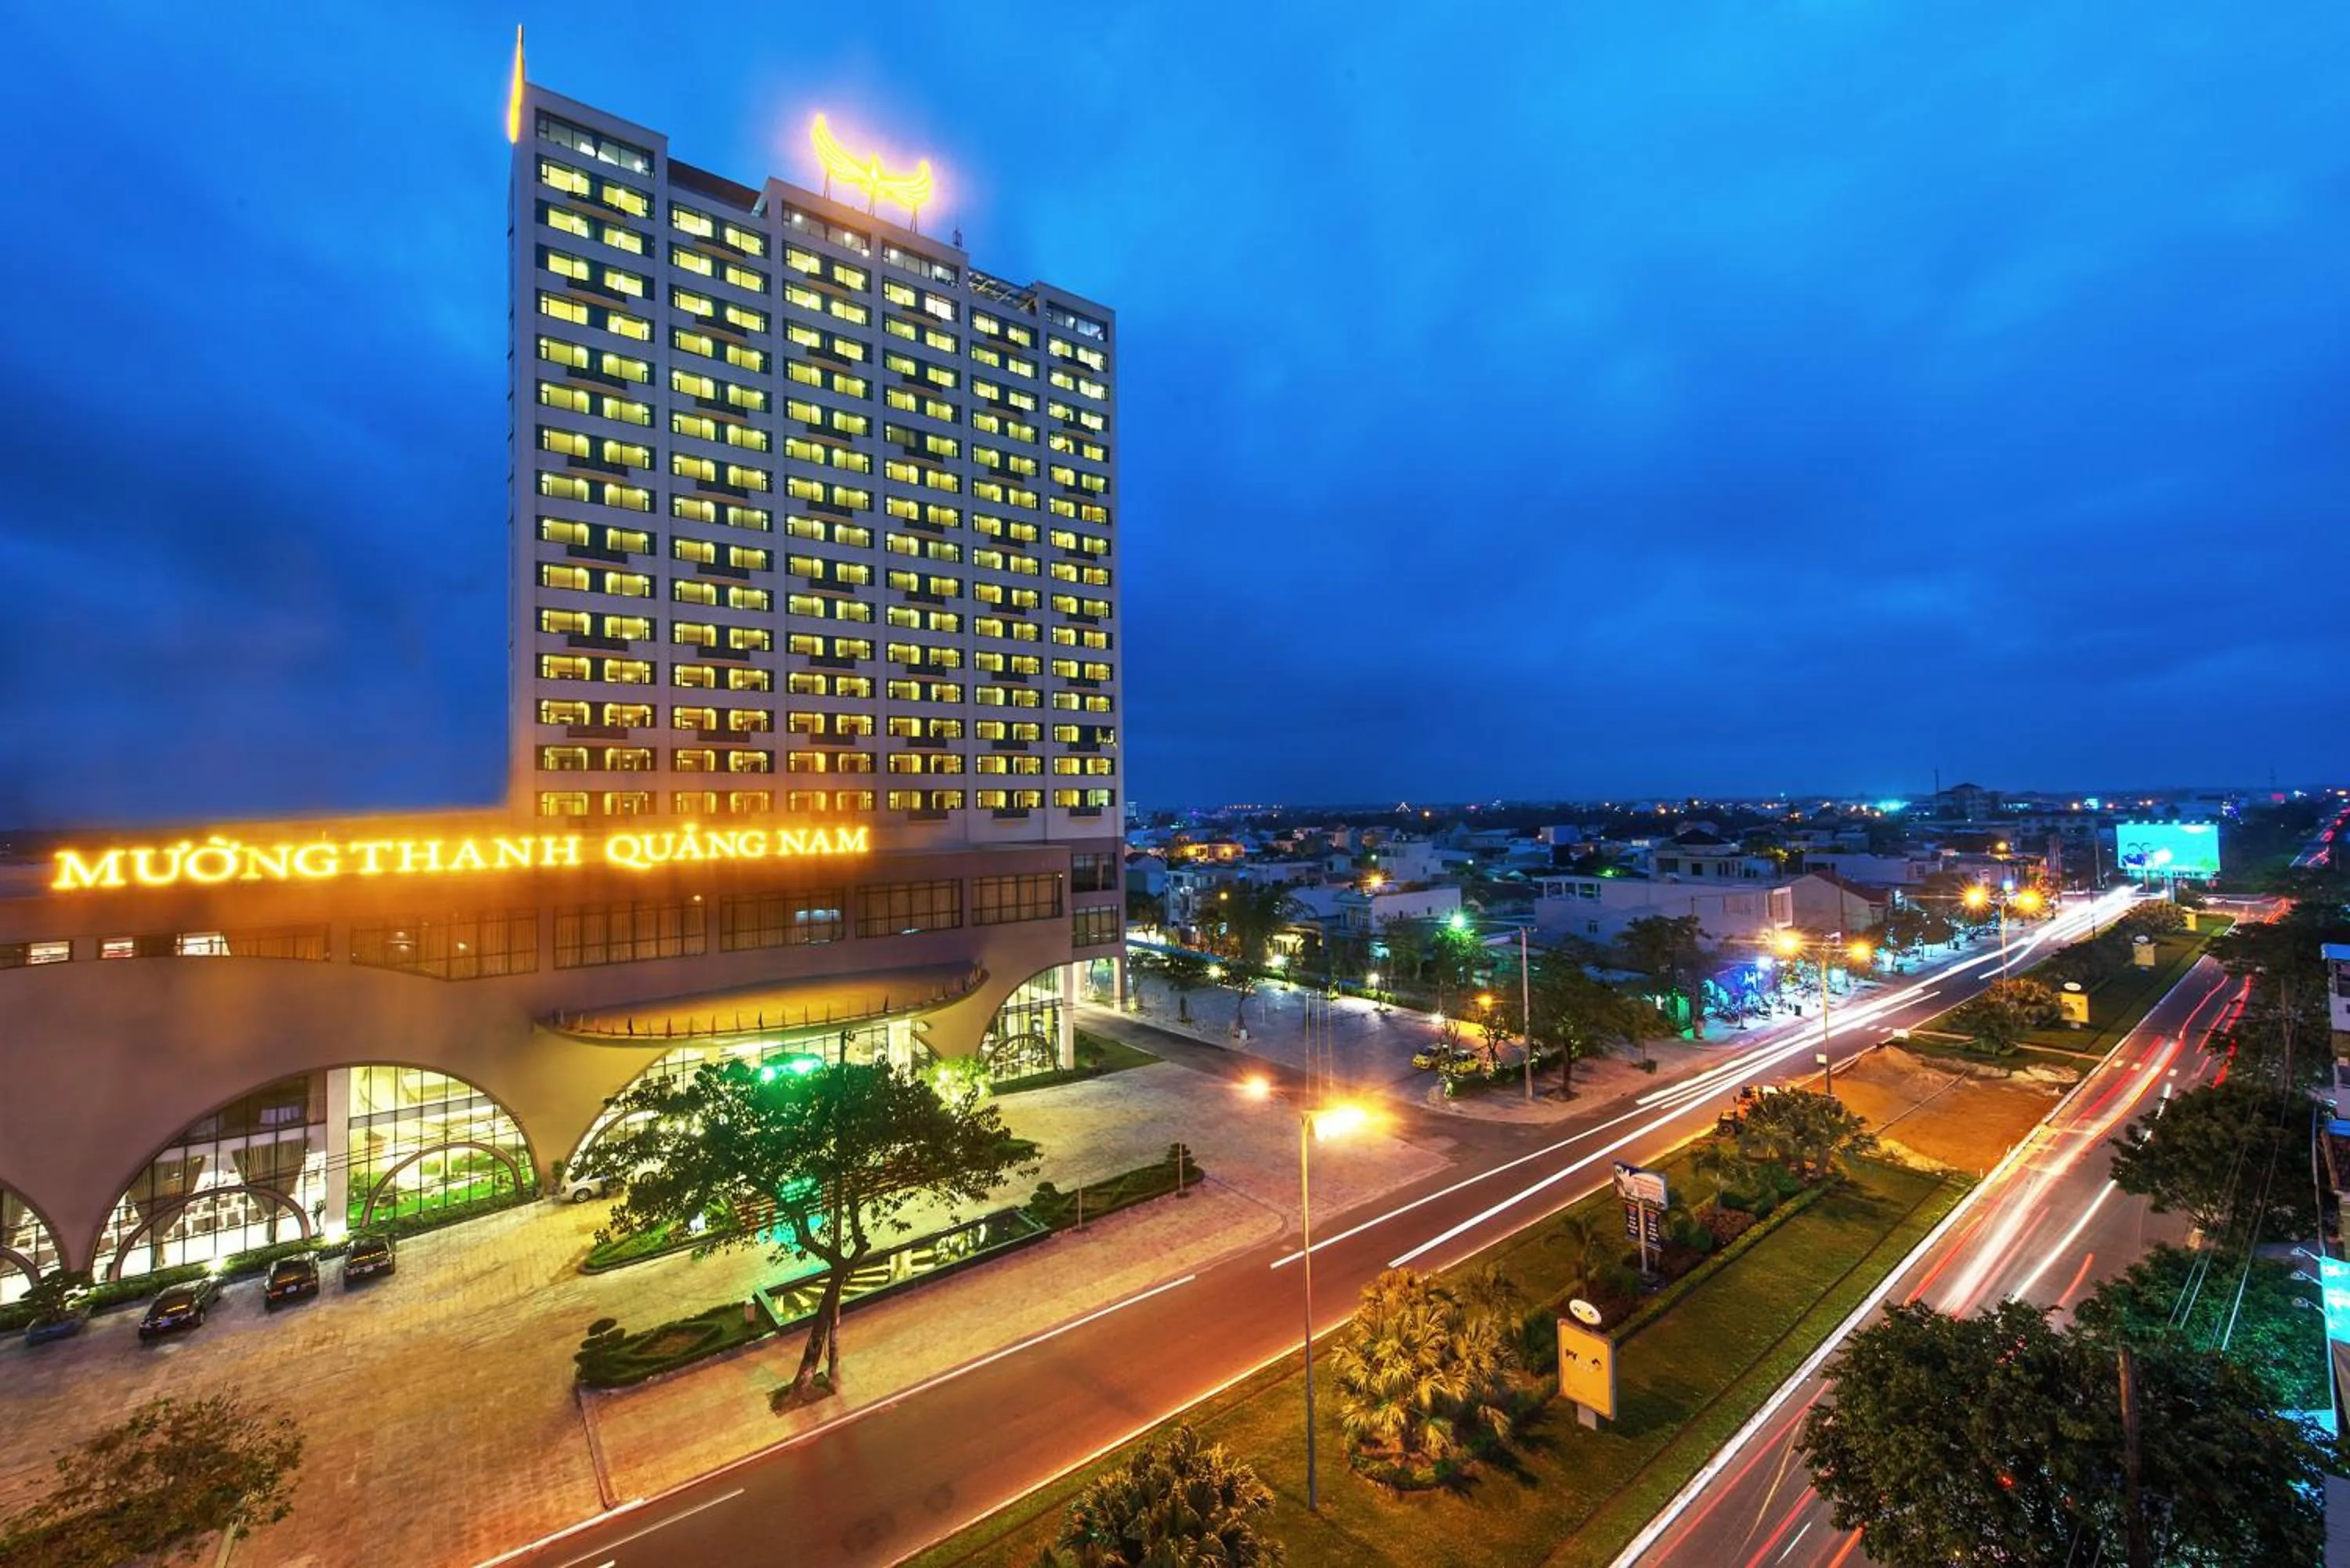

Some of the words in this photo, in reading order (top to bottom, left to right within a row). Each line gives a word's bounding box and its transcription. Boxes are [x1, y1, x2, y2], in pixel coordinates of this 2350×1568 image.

[50, 835, 339, 890] MƯỜNG
[348, 834, 582, 875] THANH
[605, 822, 768, 869] QUẢNG
[776, 826, 870, 857] NAM
